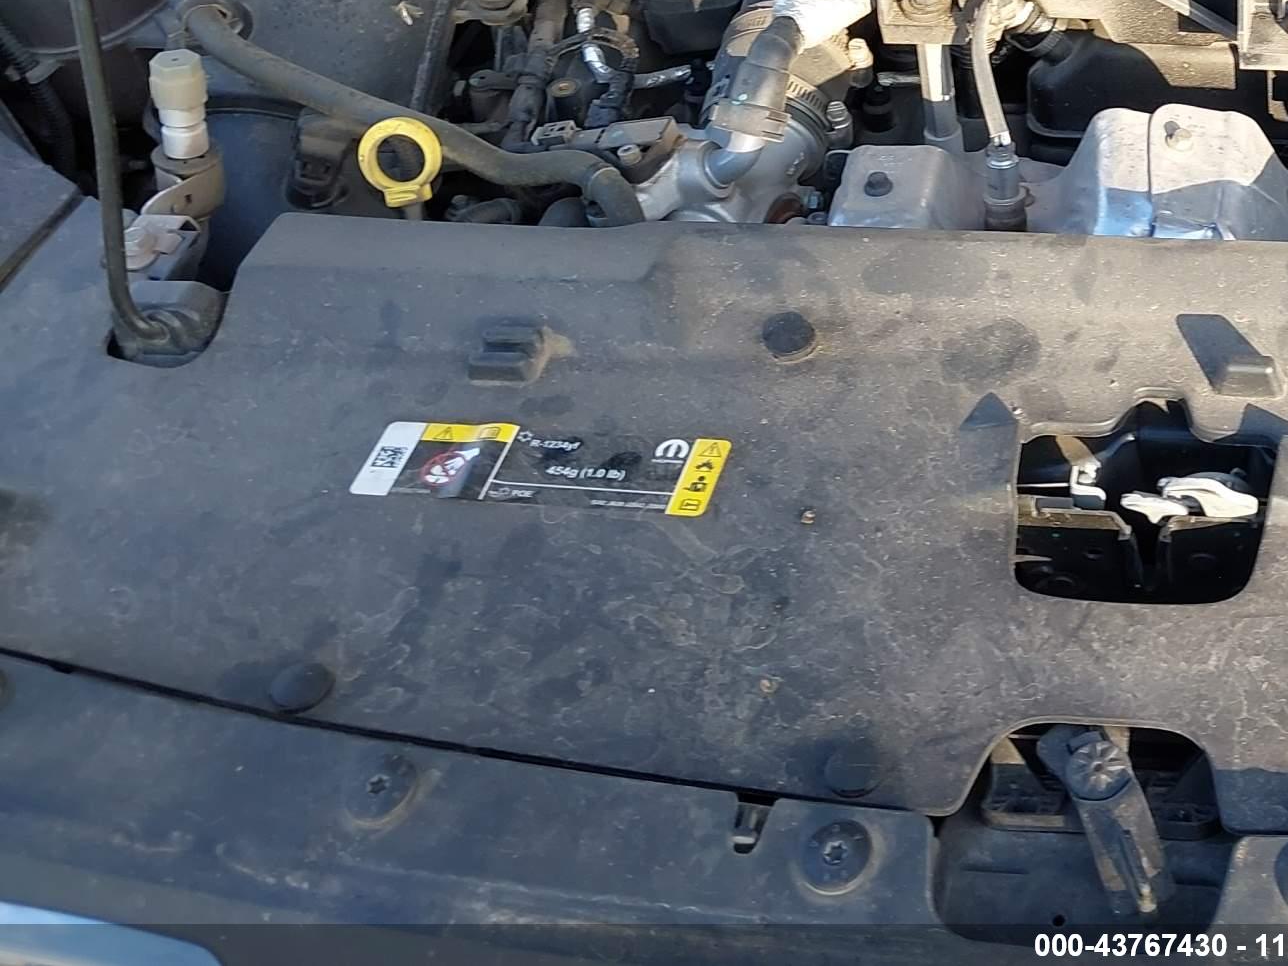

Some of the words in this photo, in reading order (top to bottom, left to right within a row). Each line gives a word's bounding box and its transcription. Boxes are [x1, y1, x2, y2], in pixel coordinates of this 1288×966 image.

[529, 439, 581, 452] R-1234yf
[545, 465, 579, 480] 454g
[605, 468, 626, 482] lb)
